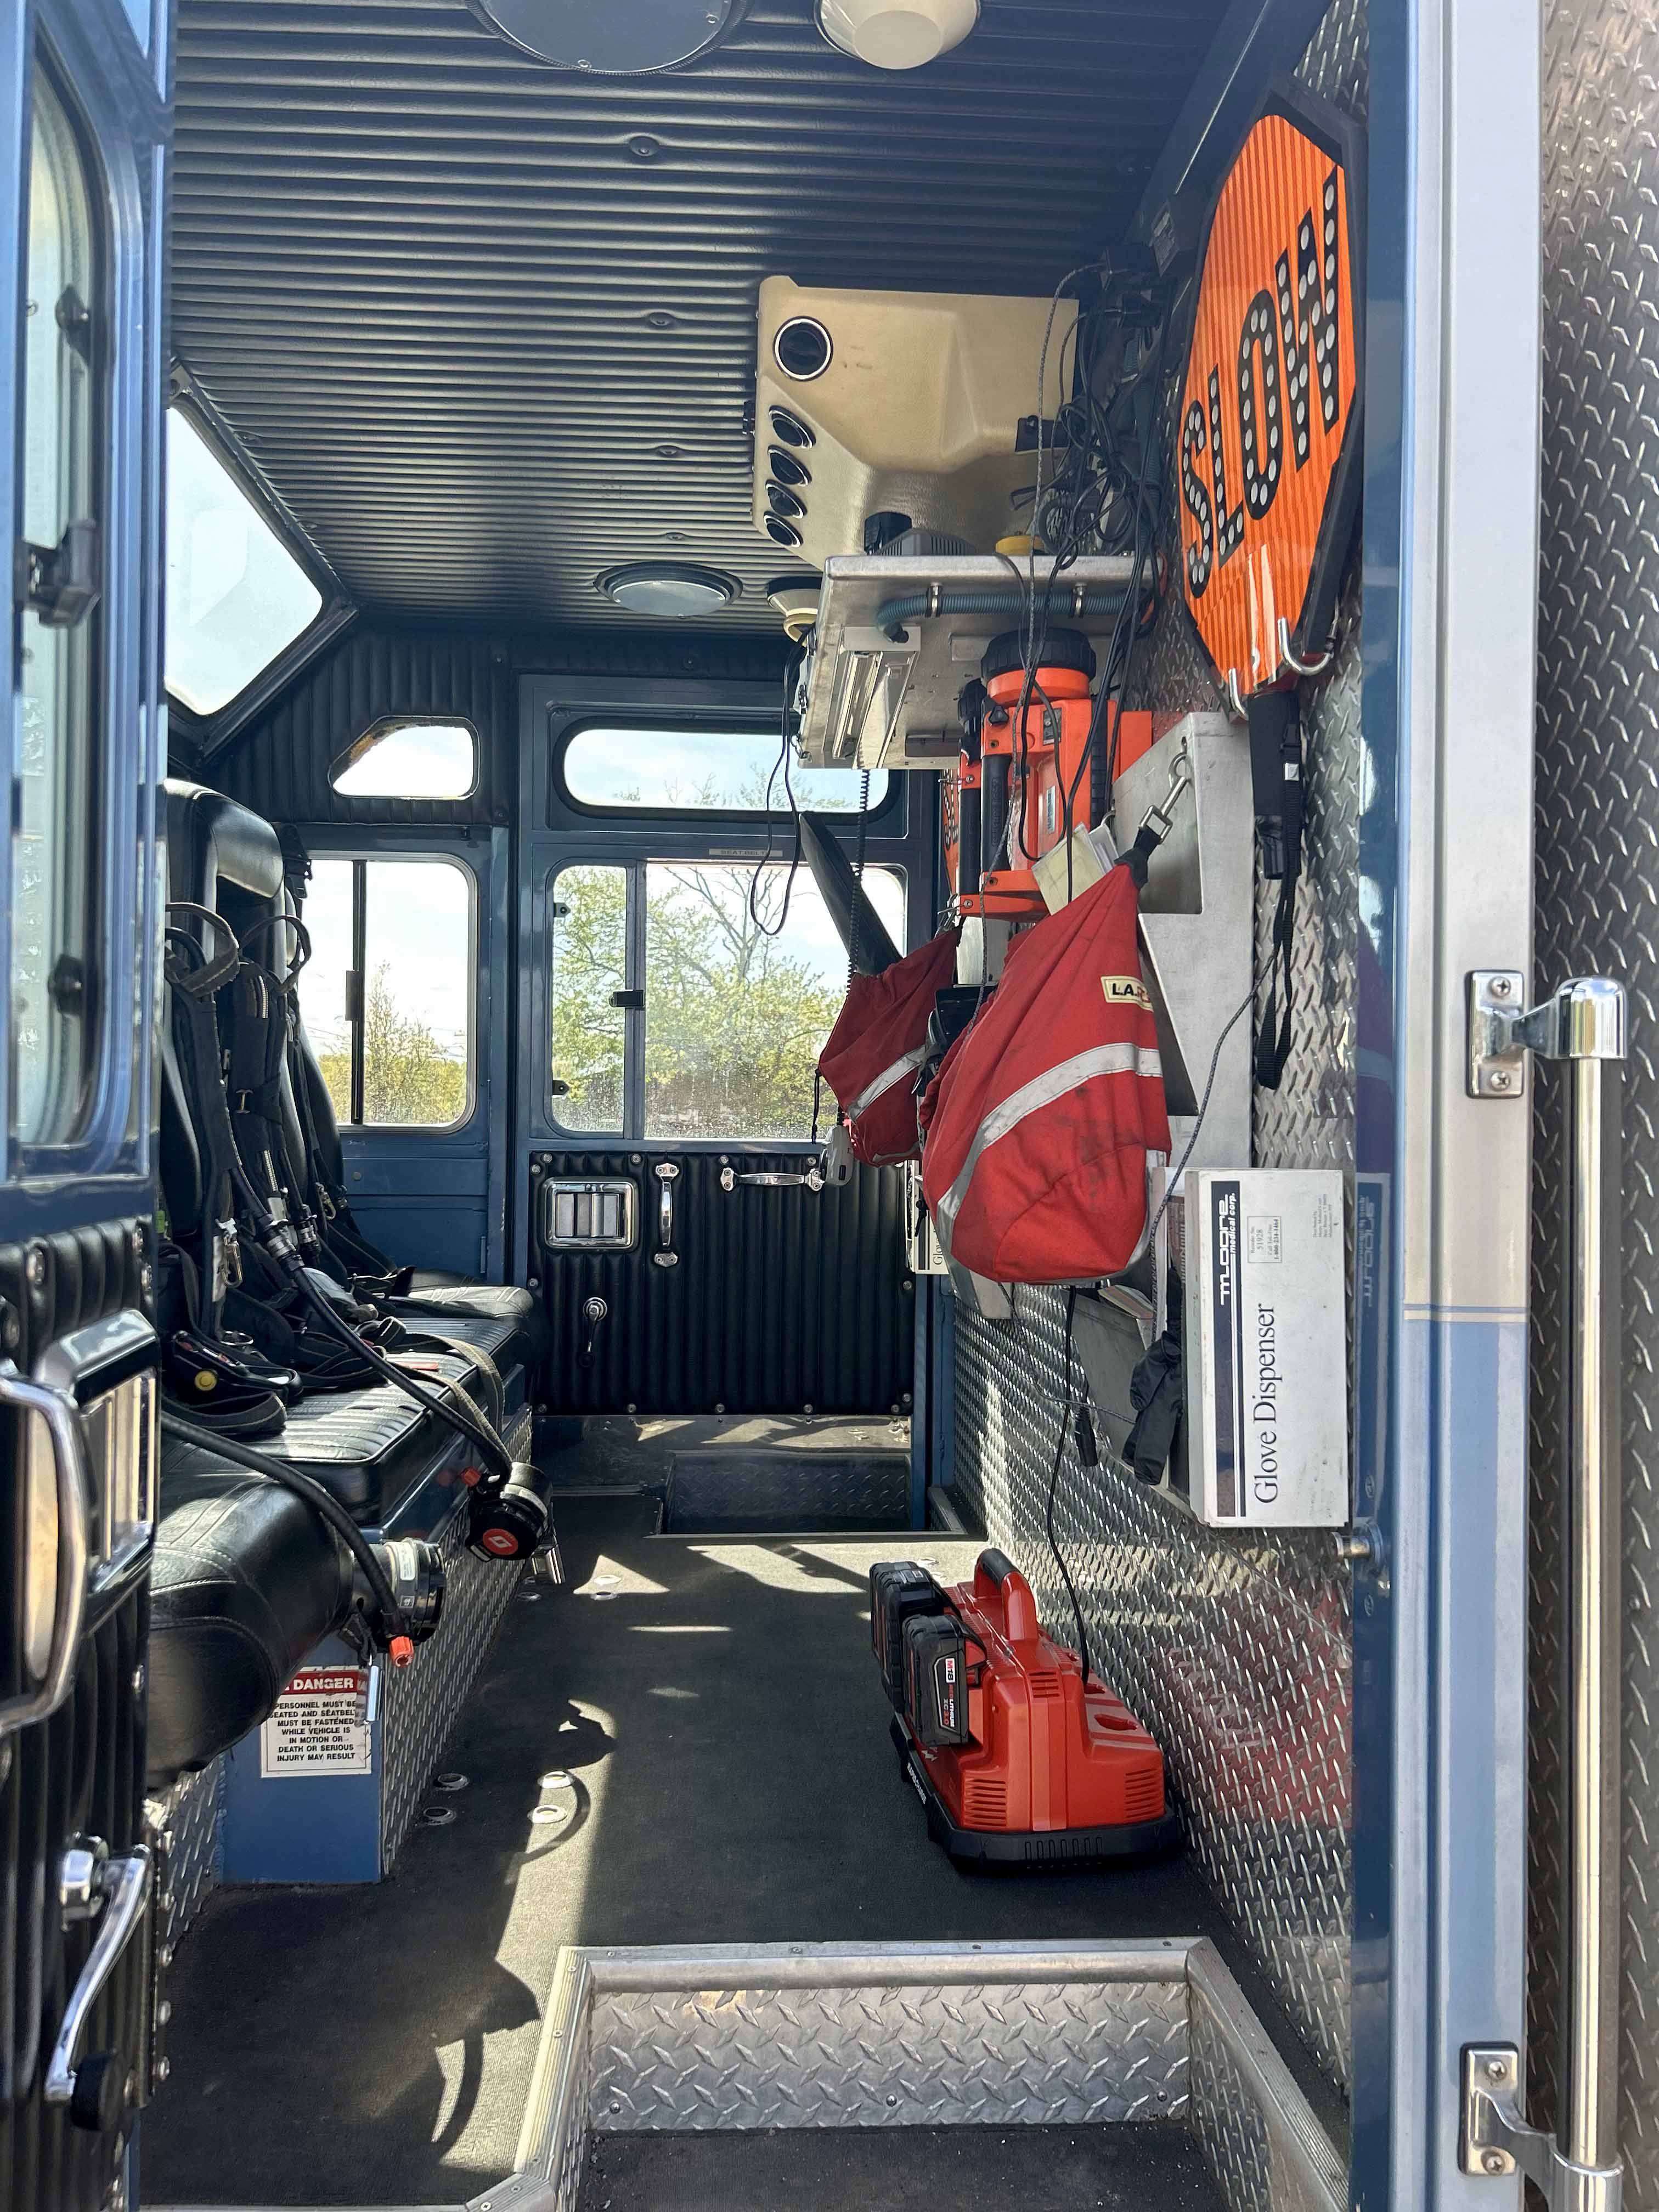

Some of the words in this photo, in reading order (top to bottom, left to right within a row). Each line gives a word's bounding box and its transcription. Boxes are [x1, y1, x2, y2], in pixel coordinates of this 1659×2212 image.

[1183, 165, 1340, 599] SLOW
[1219, 1194, 1230, 1306] moore
[1228, 1217, 1236, 1254] medical
[1252, 1303, 1283, 1424] Dispenser
[1254, 1430, 1278, 1504] Glove
[294, 1678, 354, 1690] DANGER
